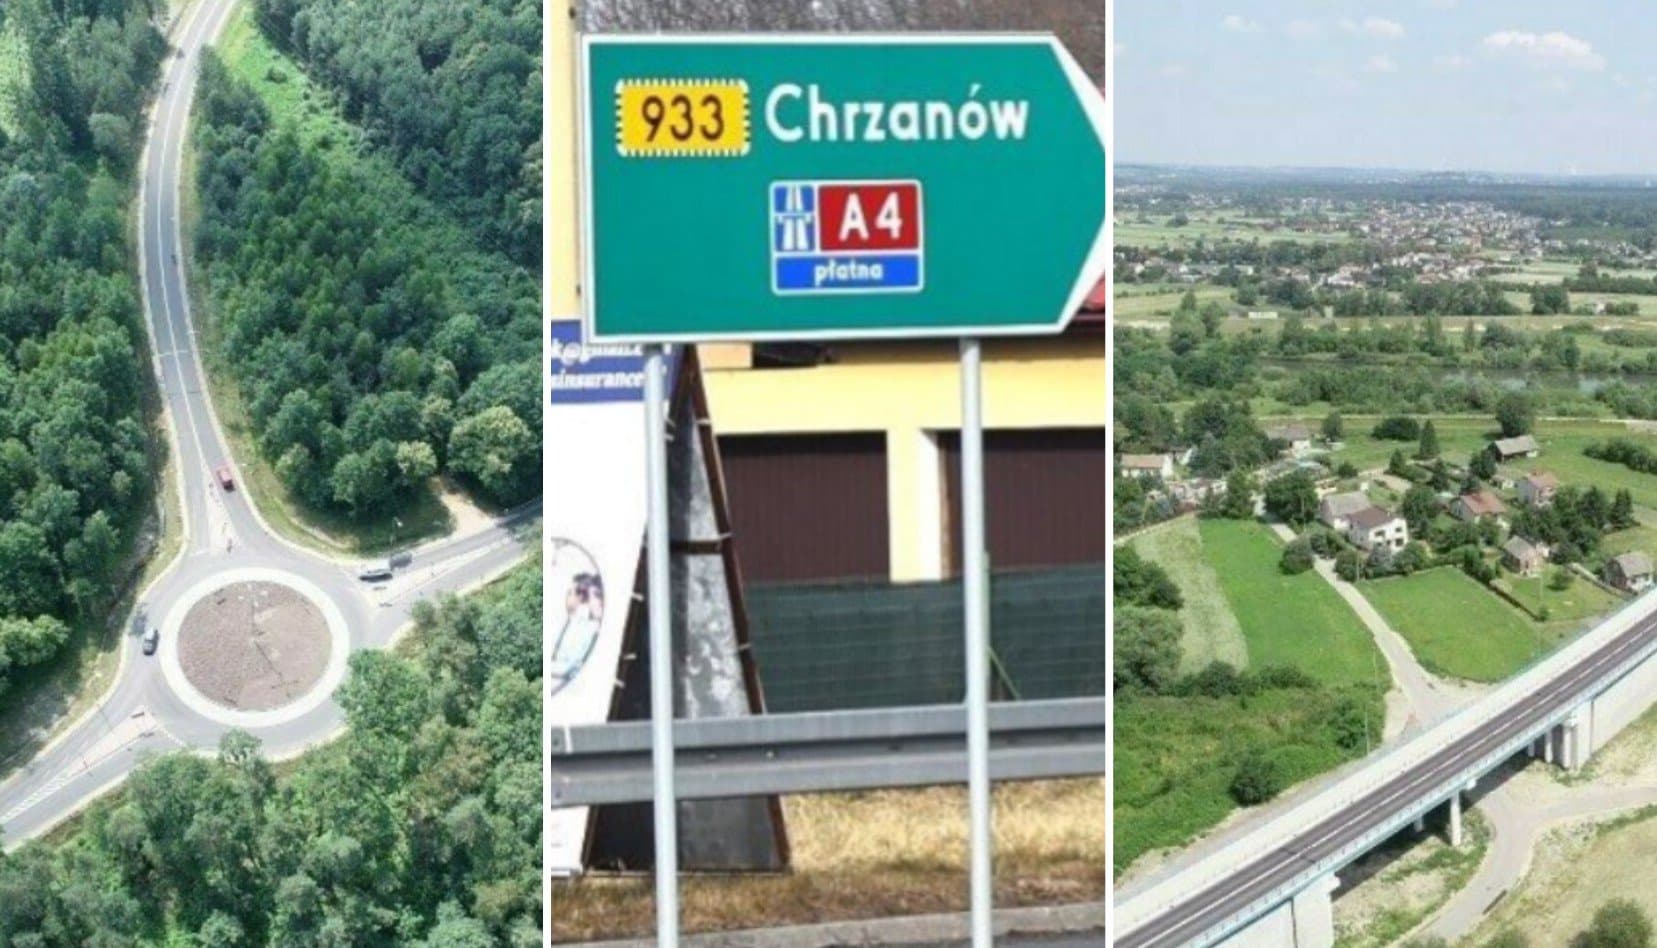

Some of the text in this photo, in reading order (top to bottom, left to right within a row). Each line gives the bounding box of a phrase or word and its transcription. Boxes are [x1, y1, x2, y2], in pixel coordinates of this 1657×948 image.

[641, 83, 1029, 142] 933 Chrzanów
[839, 191, 903, 241] A4
[814, 258, 883, 287] płatna
